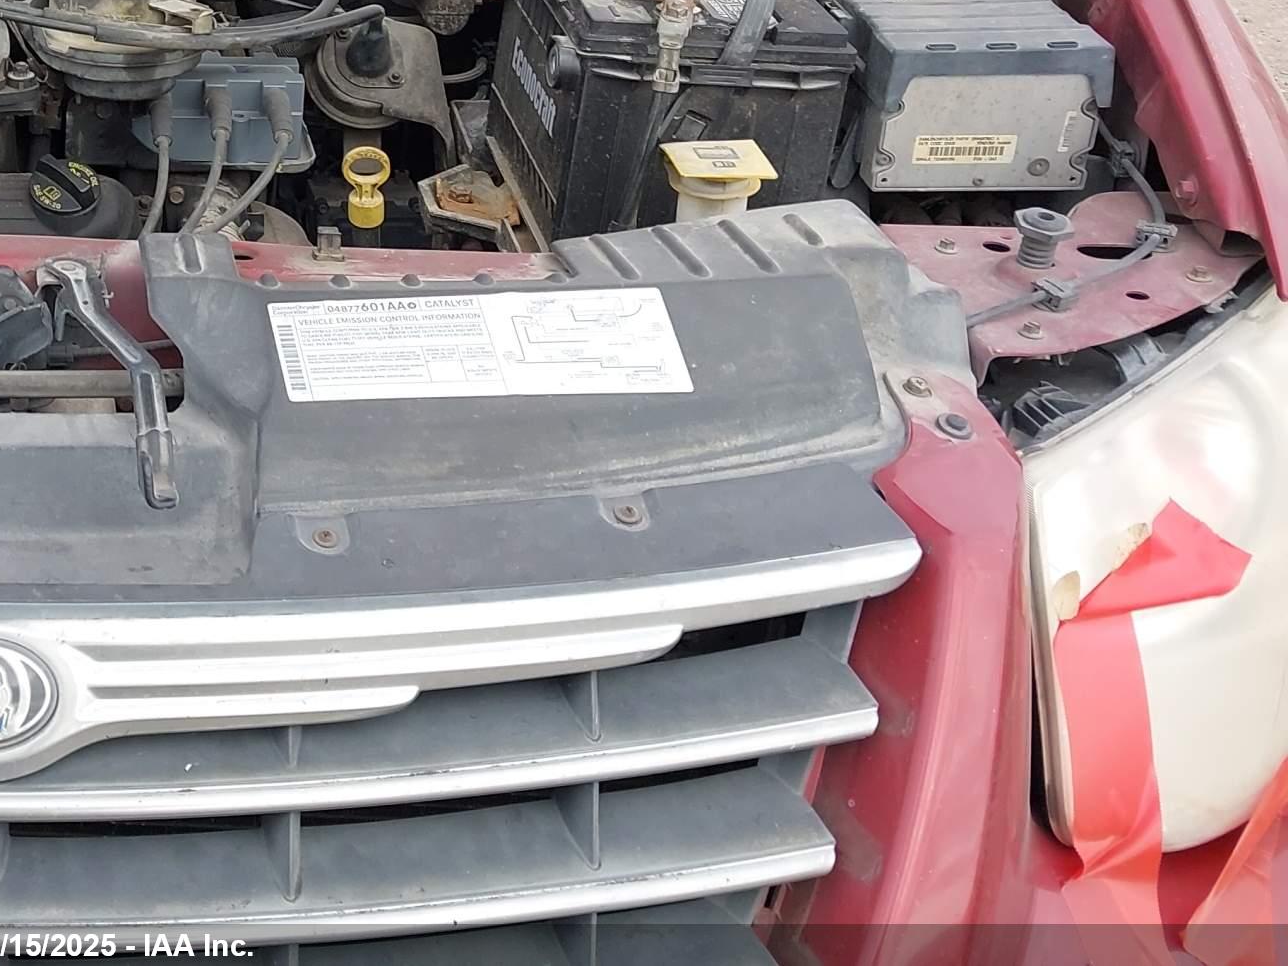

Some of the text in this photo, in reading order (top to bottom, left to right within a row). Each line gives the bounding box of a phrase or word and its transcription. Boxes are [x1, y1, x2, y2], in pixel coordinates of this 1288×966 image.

[512, 36, 556, 138] Econocraft
[424, 298, 475, 308] CATALYST
[298, 312, 481, 326] VEHICLE EMISSION CONTROL INFORMATION
